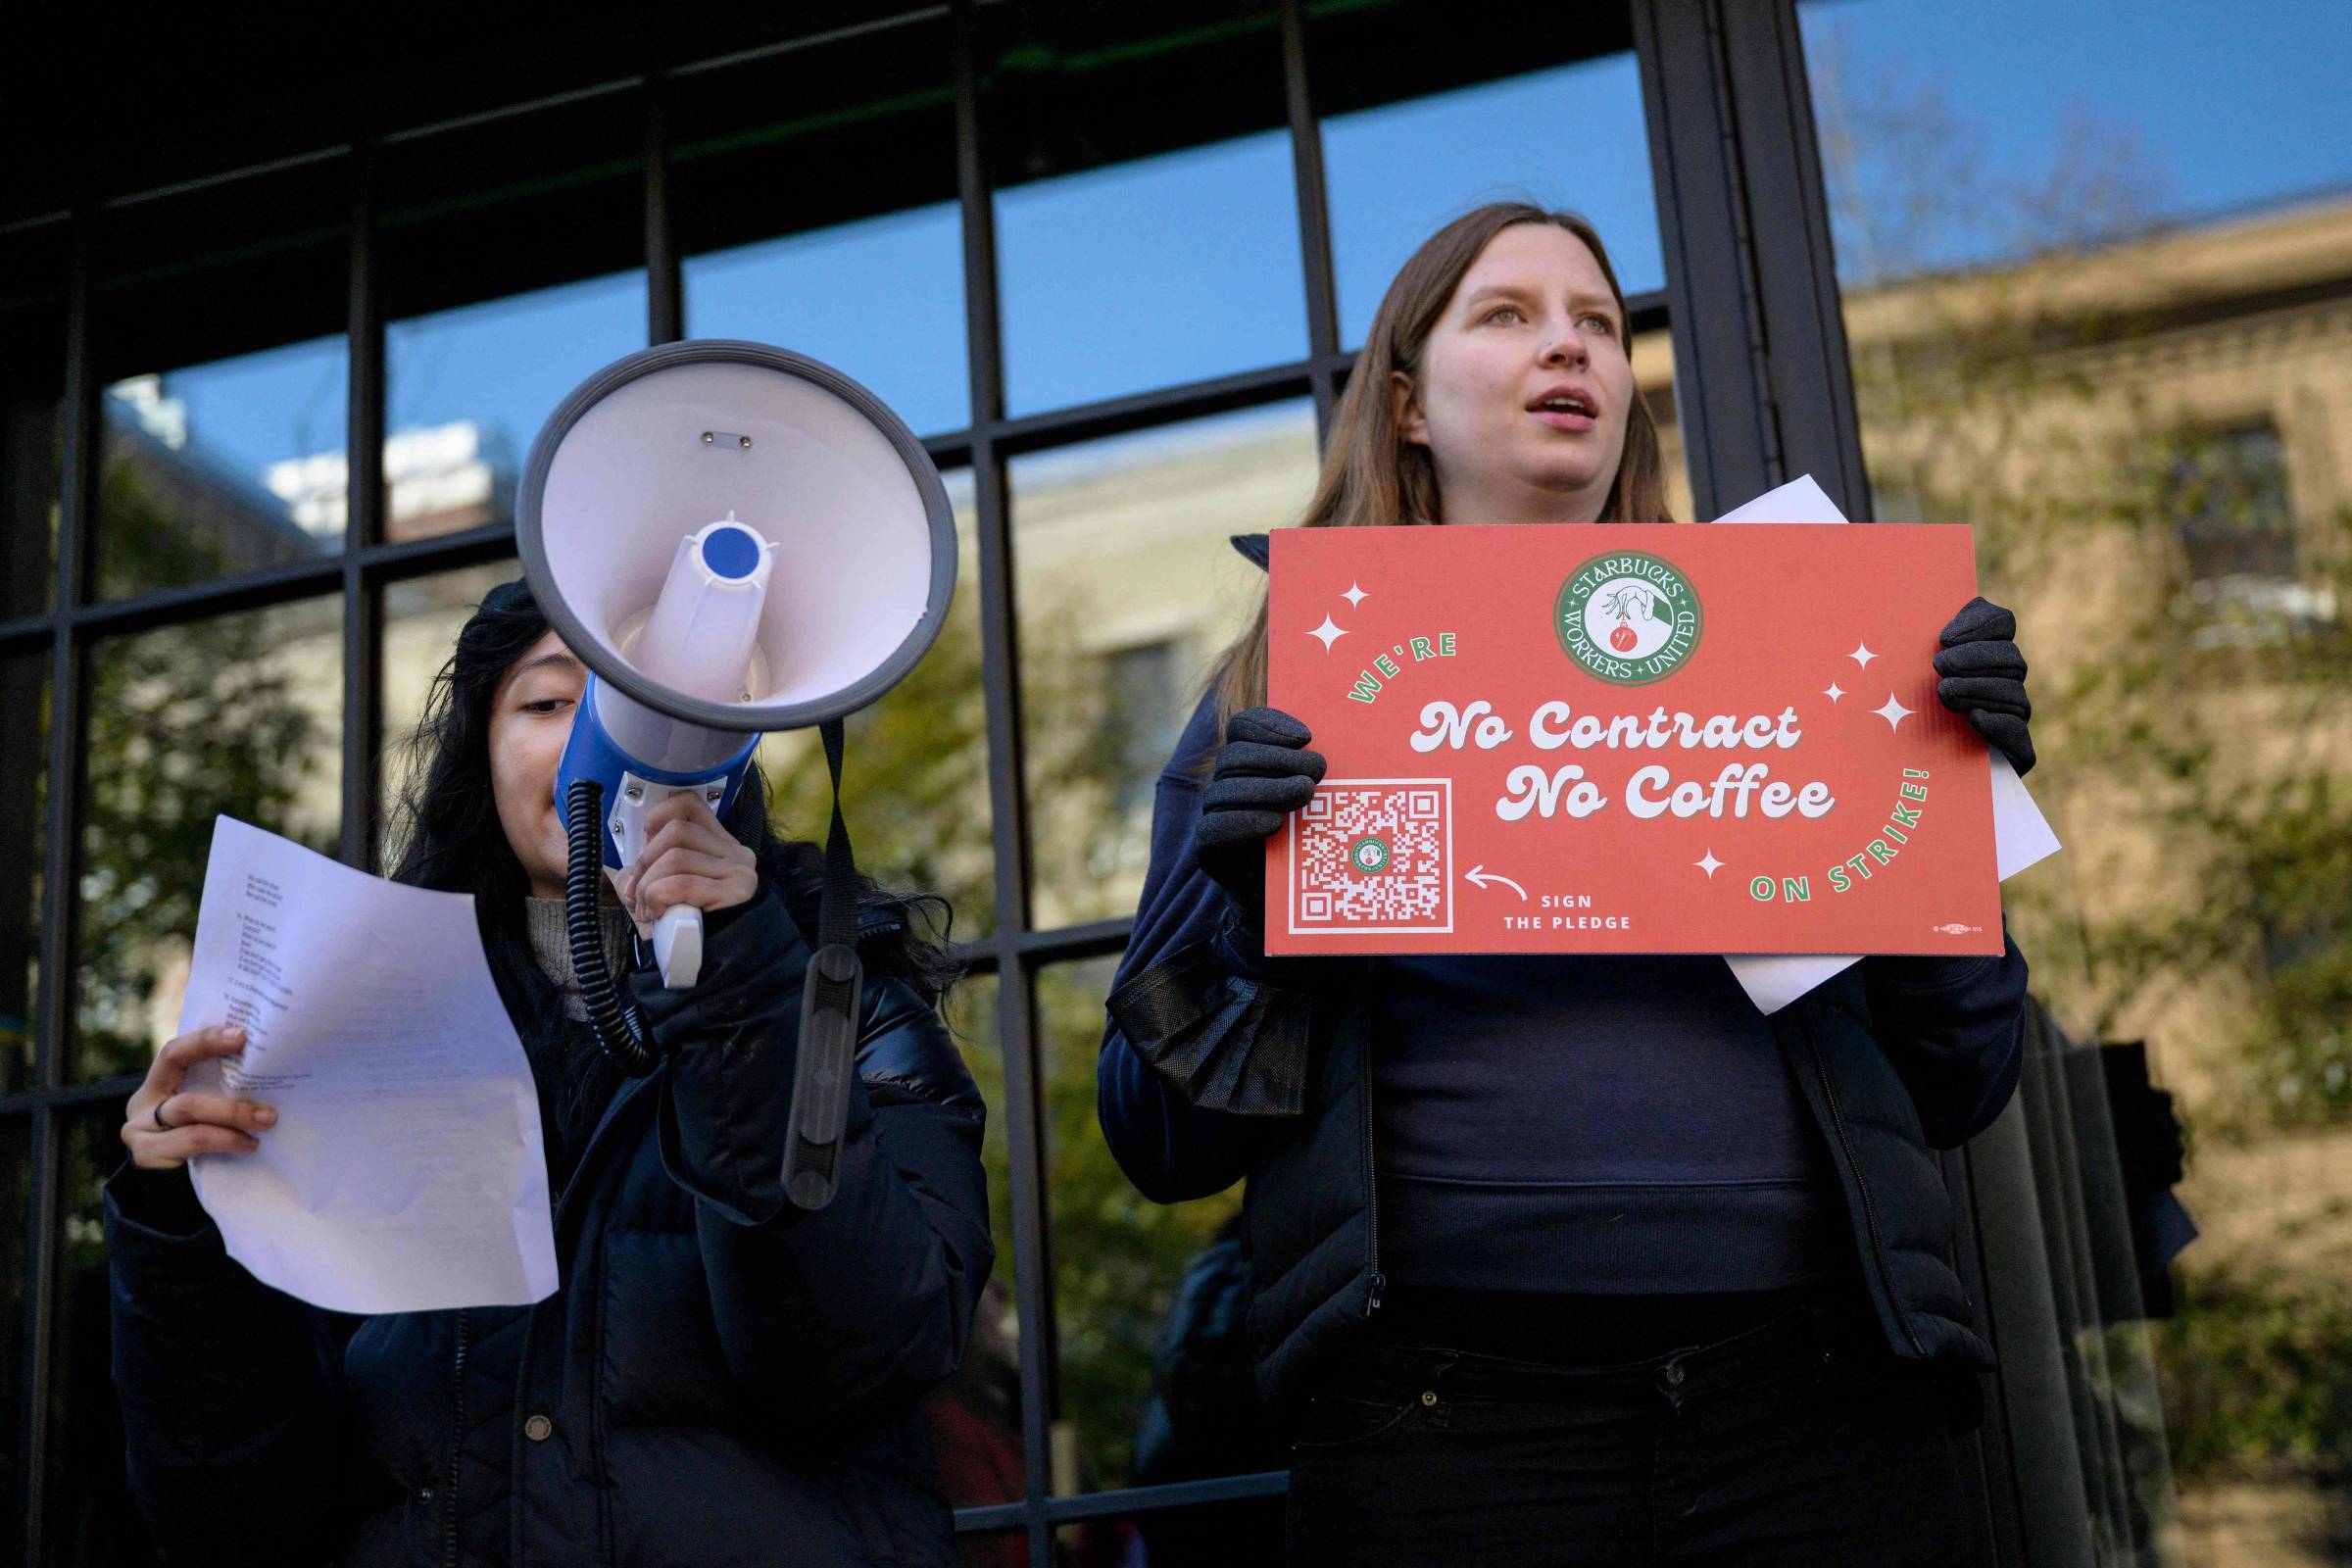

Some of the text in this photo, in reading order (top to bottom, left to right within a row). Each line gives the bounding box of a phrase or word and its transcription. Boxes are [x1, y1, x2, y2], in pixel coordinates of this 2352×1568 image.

[1572, 558, 1685, 598] STARBUCKS
[1348, 632, 1456, 704] WE'RE
[1564, 609, 1695, 678] WORKERS UNITED
[1409, 700, 1803, 754] No Contract
[1495, 762, 1837, 822] No Coffee
[1750, 767, 1930, 903] ON STRIKE!
[1504, 916, 1630, 929] THE PLEDGE
[1541, 895, 1592, 907] SIGN
